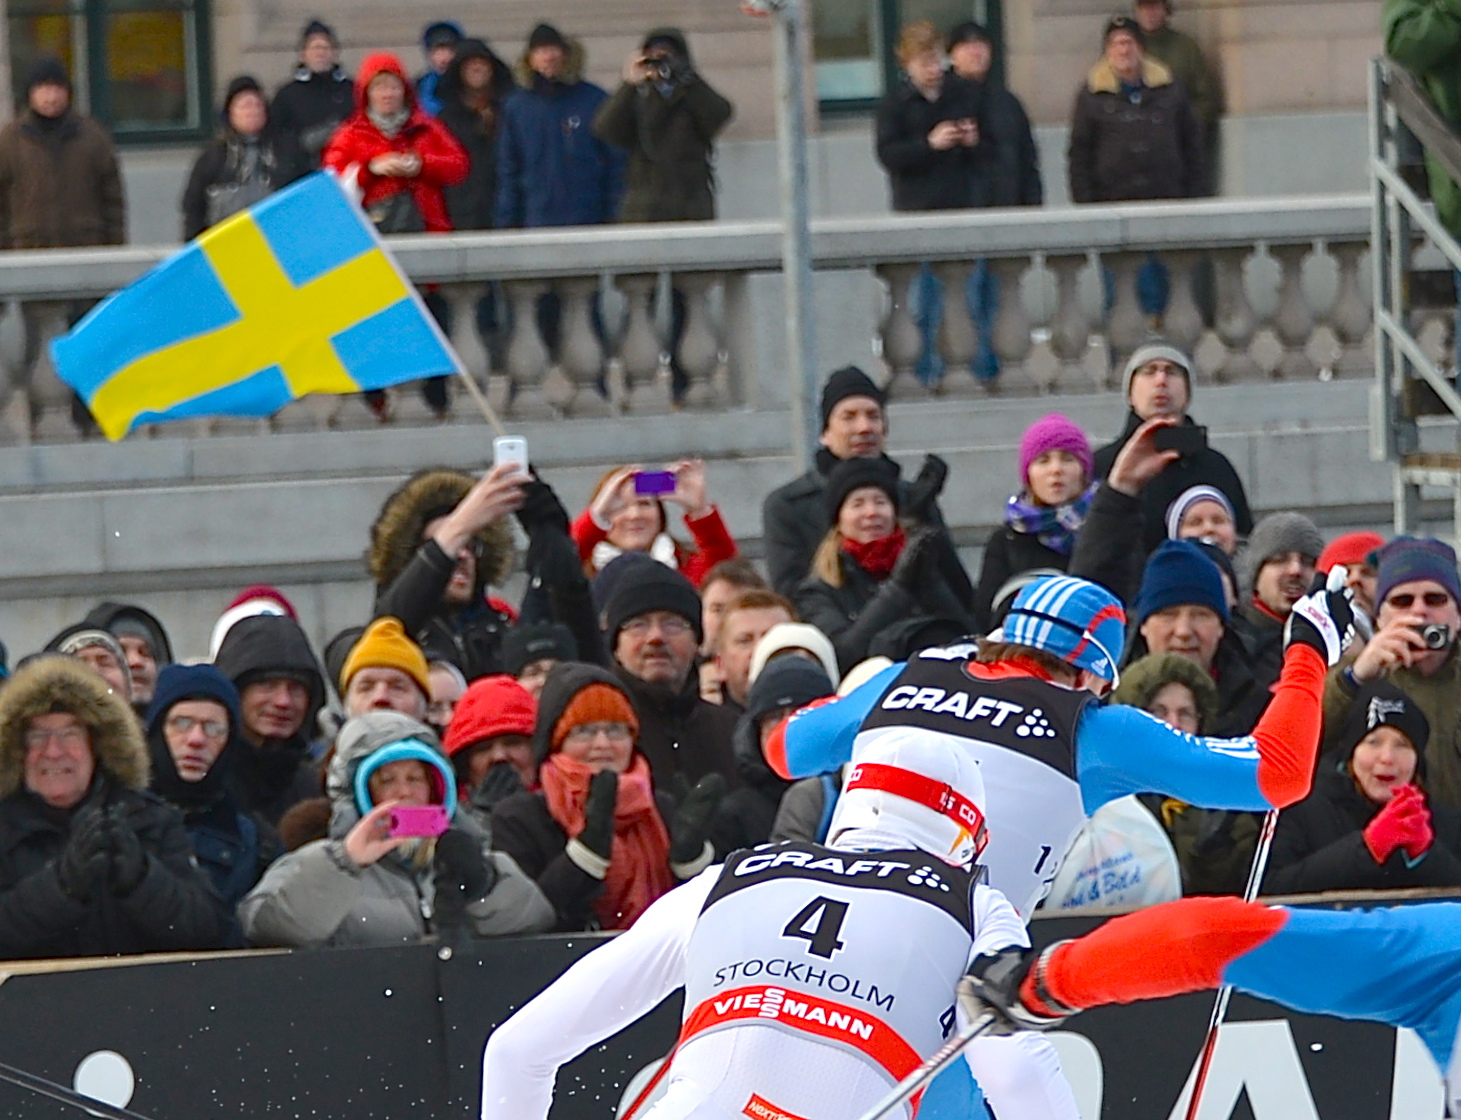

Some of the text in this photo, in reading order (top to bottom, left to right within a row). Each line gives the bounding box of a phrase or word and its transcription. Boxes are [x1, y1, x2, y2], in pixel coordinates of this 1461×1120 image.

[881, 685, 1024, 730] CRAFT
[734, 852, 911, 880] CRAFT
[782, 895, 851, 960] 4
[713, 957, 896, 1012] STOCKHOLM
[713, 987, 875, 1041] VIESSMANN
